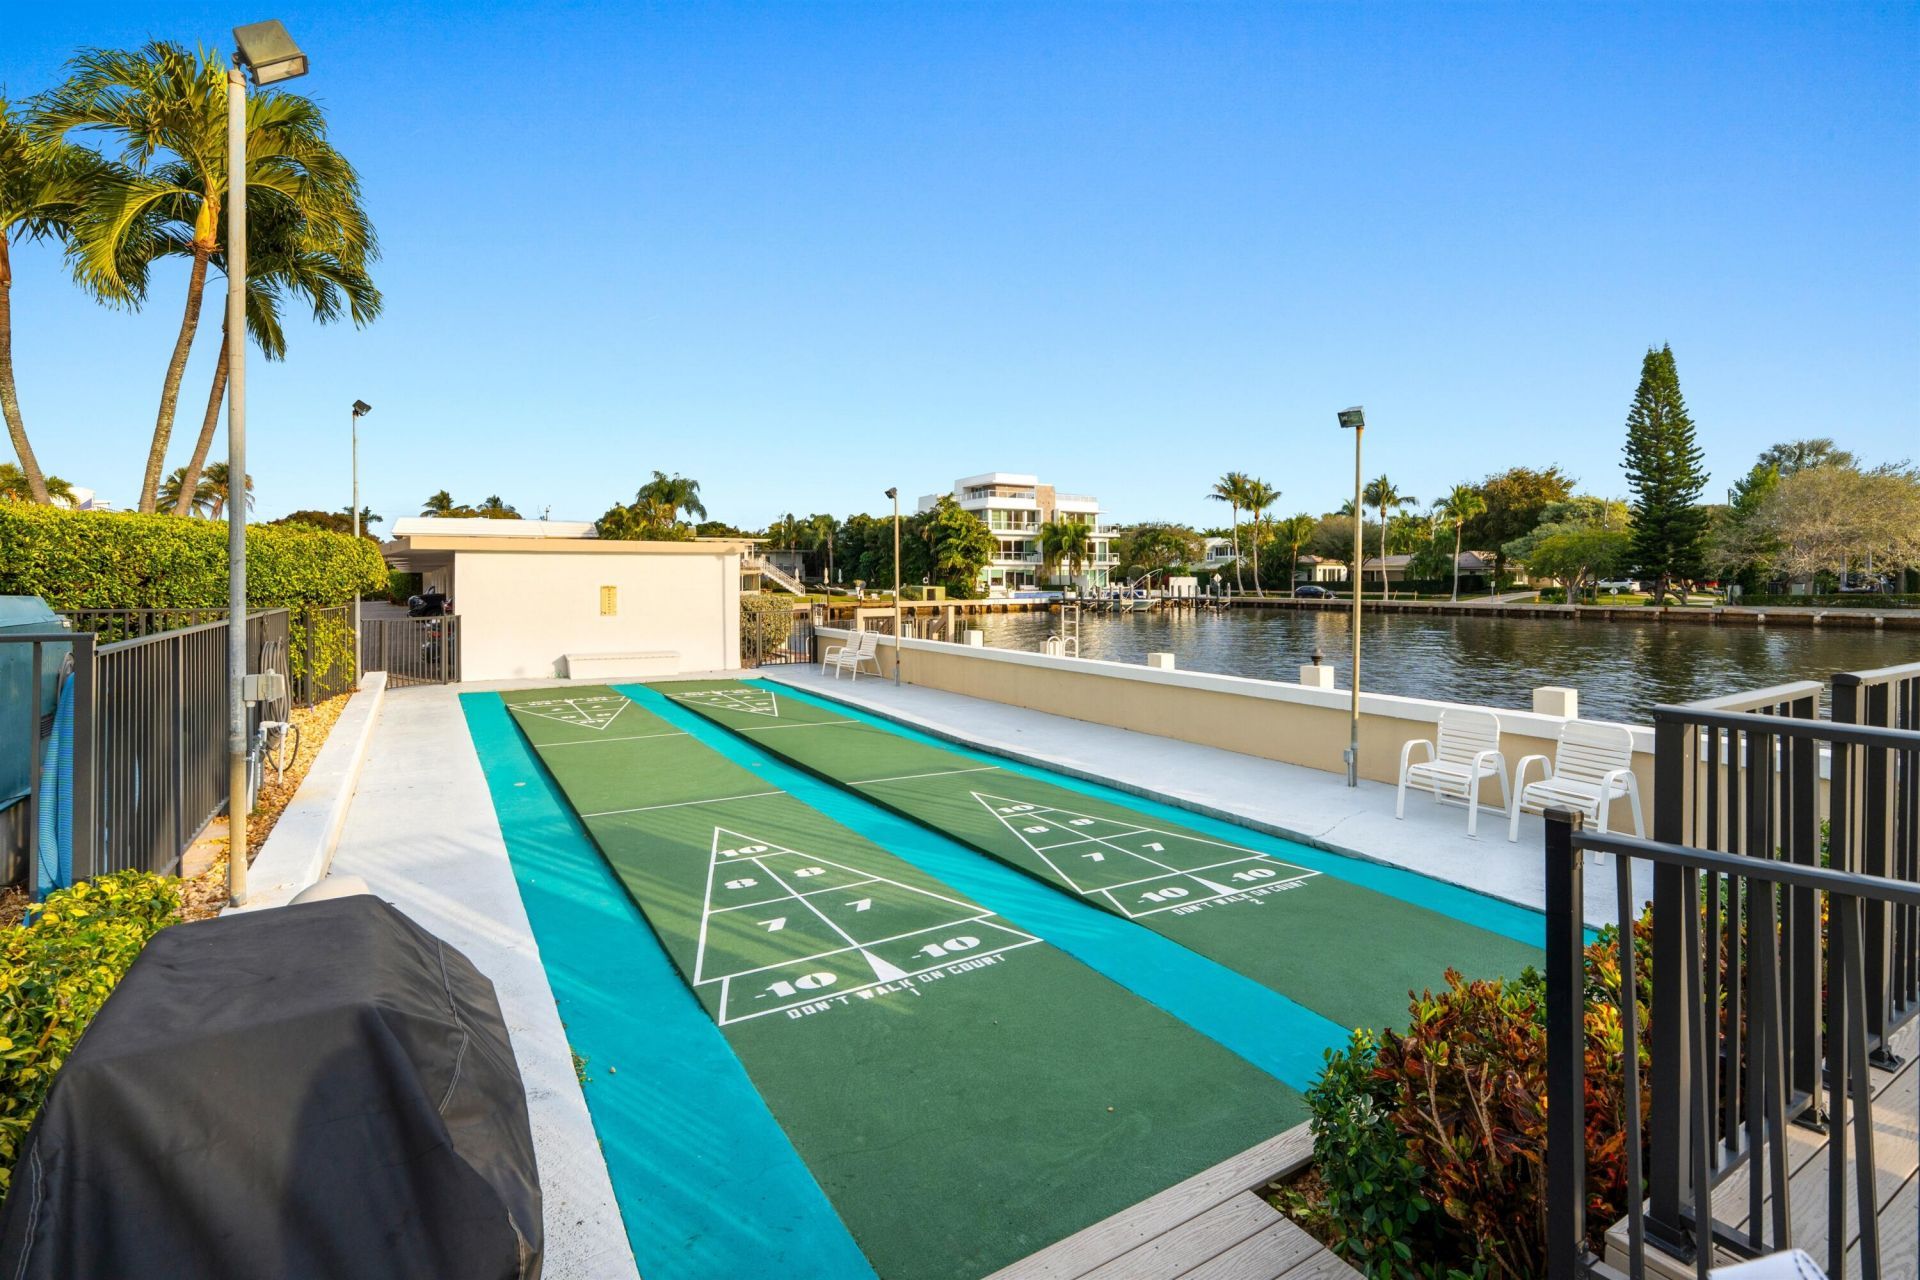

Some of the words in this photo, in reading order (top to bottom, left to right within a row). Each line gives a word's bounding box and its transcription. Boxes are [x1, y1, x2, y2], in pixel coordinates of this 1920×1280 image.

[997, 804, 1034, 813] 10
[1069, 818, 1095, 826] 8
[1022, 825, 1050, 834] 8
[718, 845, 769, 858] 10
[1141, 842, 1165, 852] 7
[1081, 851, 1105, 862] 7
[793, 866, 826, 878] 8
[724, 878, 758, 890] 8
[1137, 887, 1190, 902] -10
[1171, 901, 1213, 916] DON'T
[1213, 893, 1254, 905] WALK
[1249, 888, 1272, 897] ON
[1269, 880, 1309, 892] COURT
[844, 898, 872, 913] 7
[756, 917, 787, 933] 7
[911, 936, 981, 959] -10
[755, 971, 838, 999] -10
[786, 995, 850, 1020] DON'T
[855, 978, 916, 1000] WALK
[917, 970, 946, 984] ON
[946, 953, 1006, 975] COURT
[909, 987, 922, 997] 1
